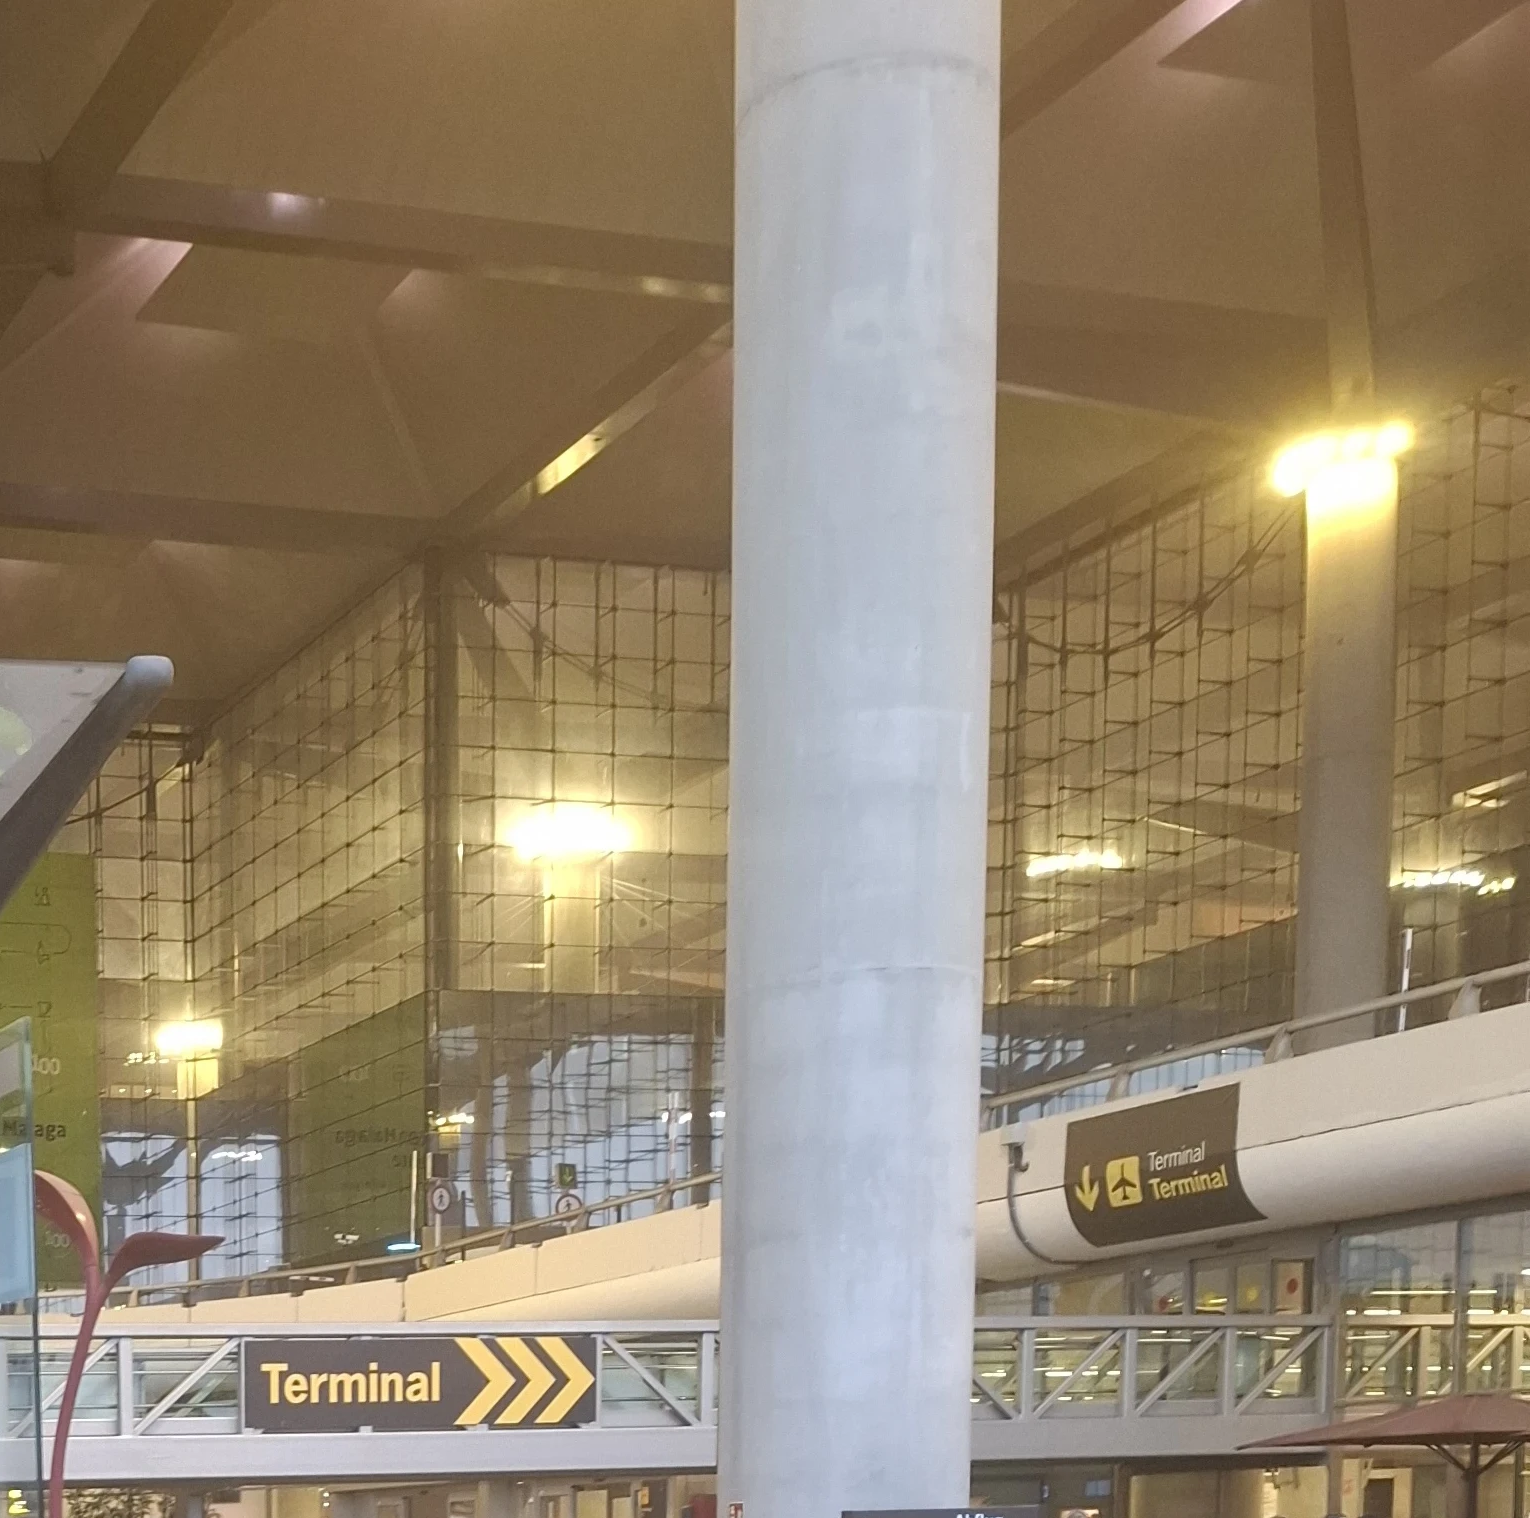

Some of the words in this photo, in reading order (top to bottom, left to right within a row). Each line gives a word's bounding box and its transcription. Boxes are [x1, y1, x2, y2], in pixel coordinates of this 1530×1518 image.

[3, 1120, 67, 1141] Maaga
[1147, 1140, 1206, 1172] Terminal
[1148, 1163, 1229, 1200] Terminal
[260, 1361, 441, 1404] Terminal
